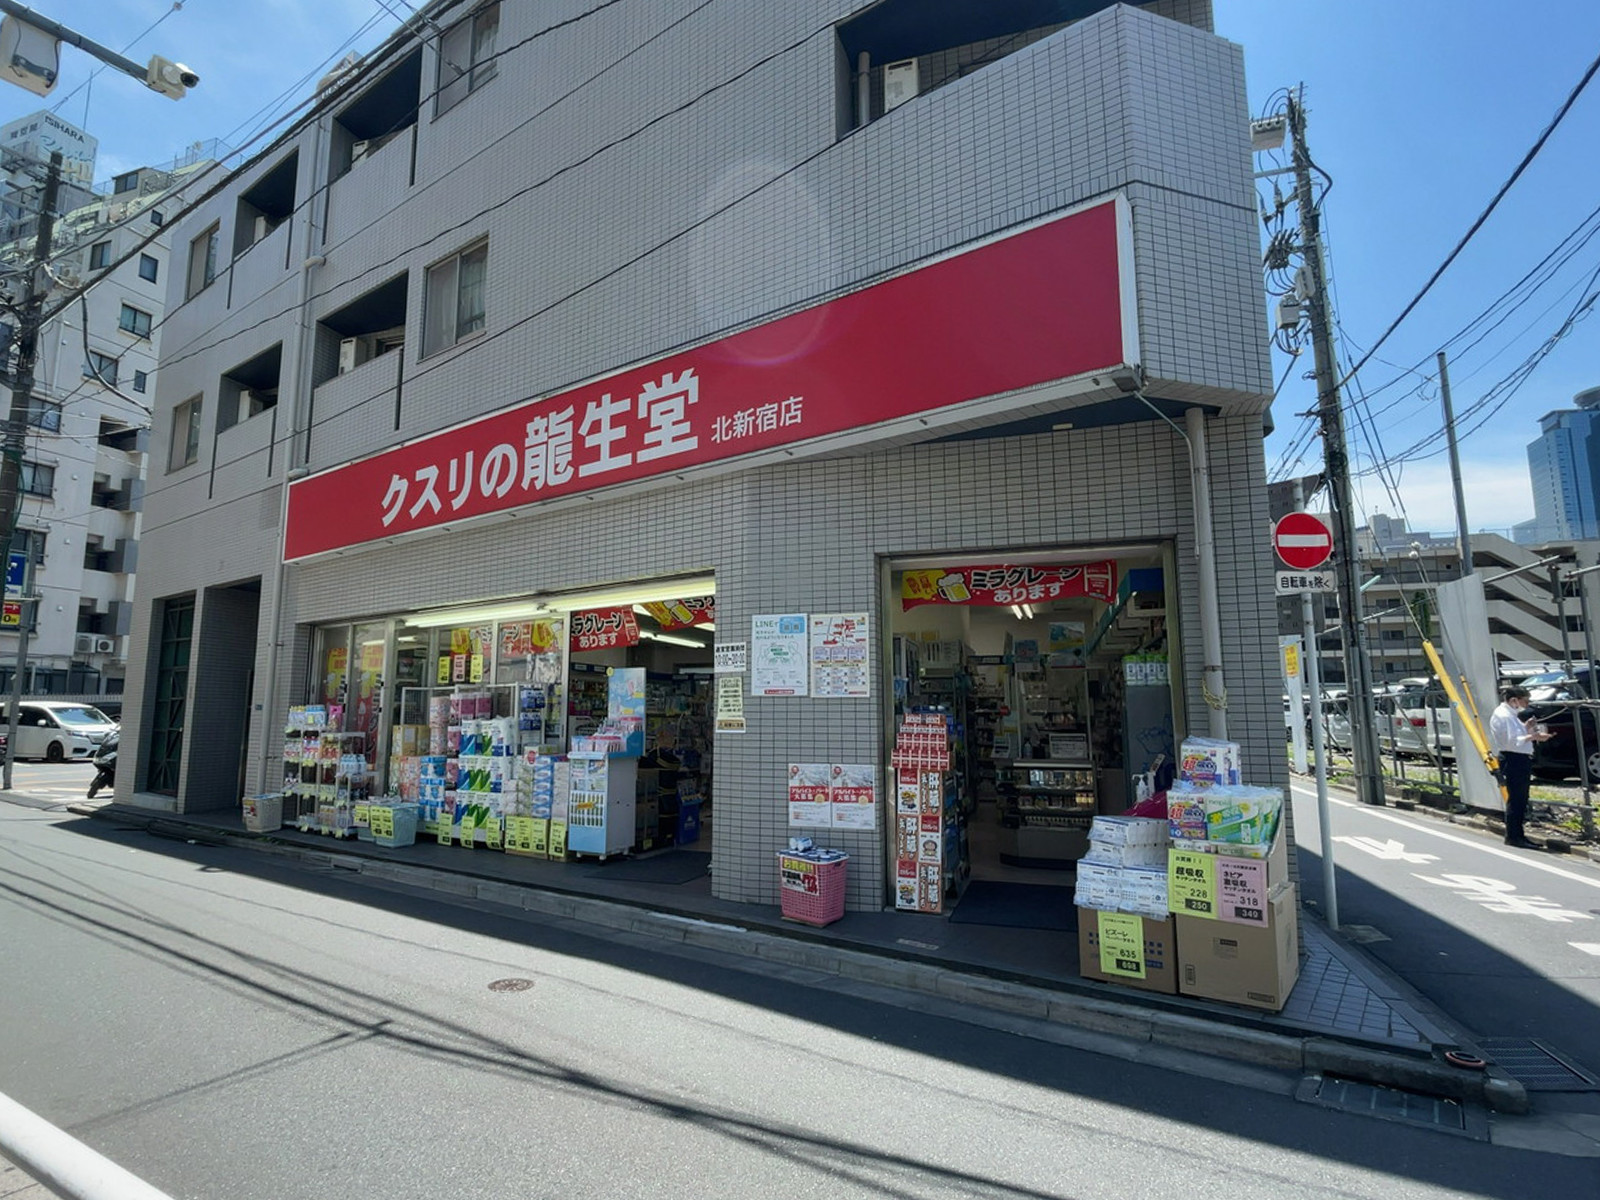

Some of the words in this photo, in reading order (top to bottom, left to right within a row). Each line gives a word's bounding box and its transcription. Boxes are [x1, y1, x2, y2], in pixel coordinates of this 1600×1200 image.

[711, 396, 803, 443] 北新宿店
[381, 368, 699, 527] クスリの龍生堂
[970, 567, 1082, 589] ミラグレーン
[1280, 576, 1330, 589] 自転車を除く
[993, 582, 1064, 603] あります
[579, 632, 618, 648] あります
[1190, 888, 1208, 898] 228
[1240, 896, 1259, 906] 318
[1241, 909, 1259, 918] 349
[1120, 949, 1137, 959] 635
